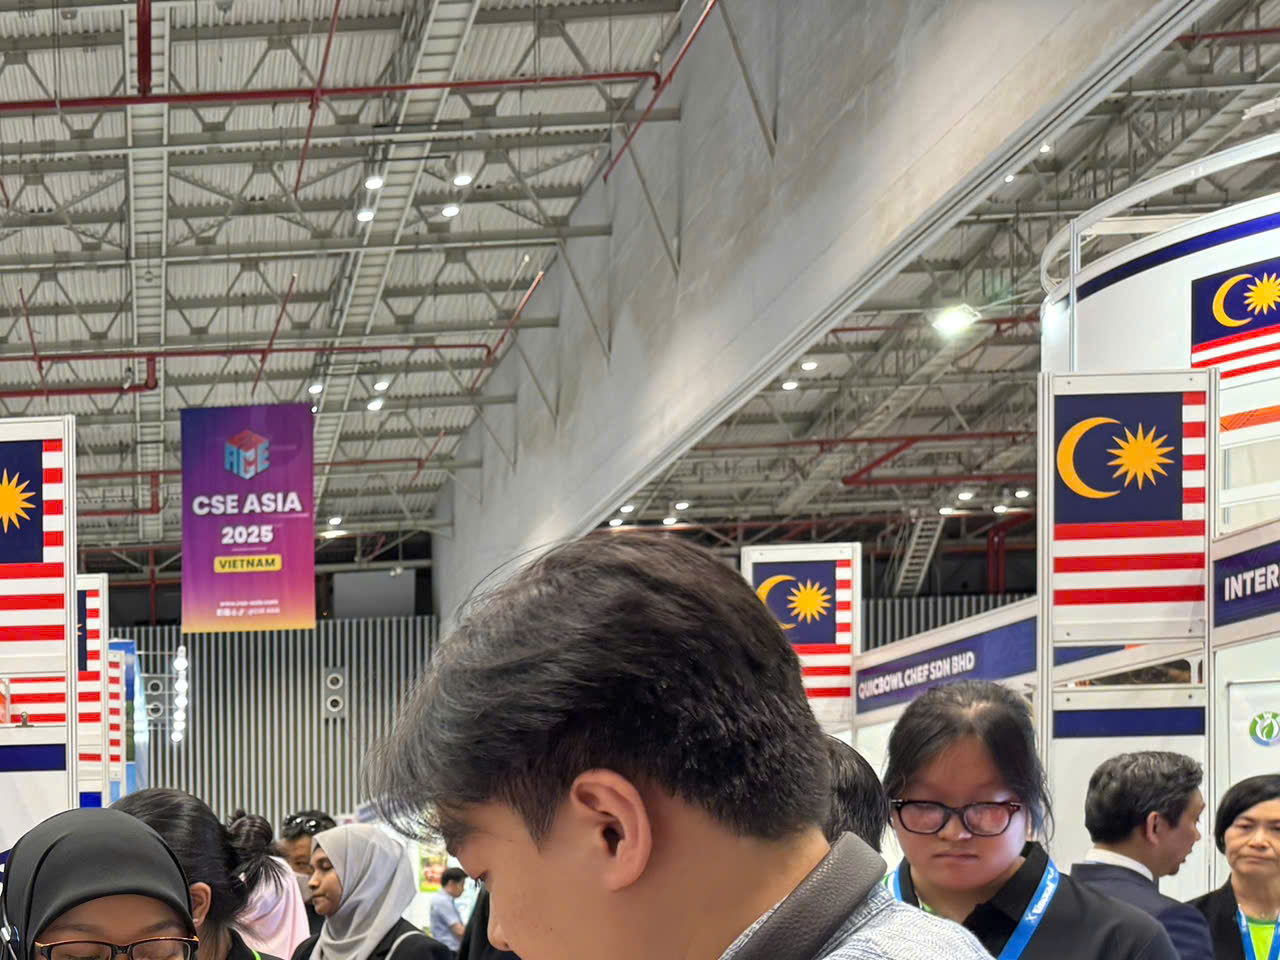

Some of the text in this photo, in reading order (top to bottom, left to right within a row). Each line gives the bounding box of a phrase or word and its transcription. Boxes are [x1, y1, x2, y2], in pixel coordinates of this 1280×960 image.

[192, 492, 302, 516] CSE ASIA
[221, 524, 273, 545] 2025
[219, 556, 276, 570] VIETNAM
[858, 650, 975, 700] QUICBOWL CHEF SDN BHD
